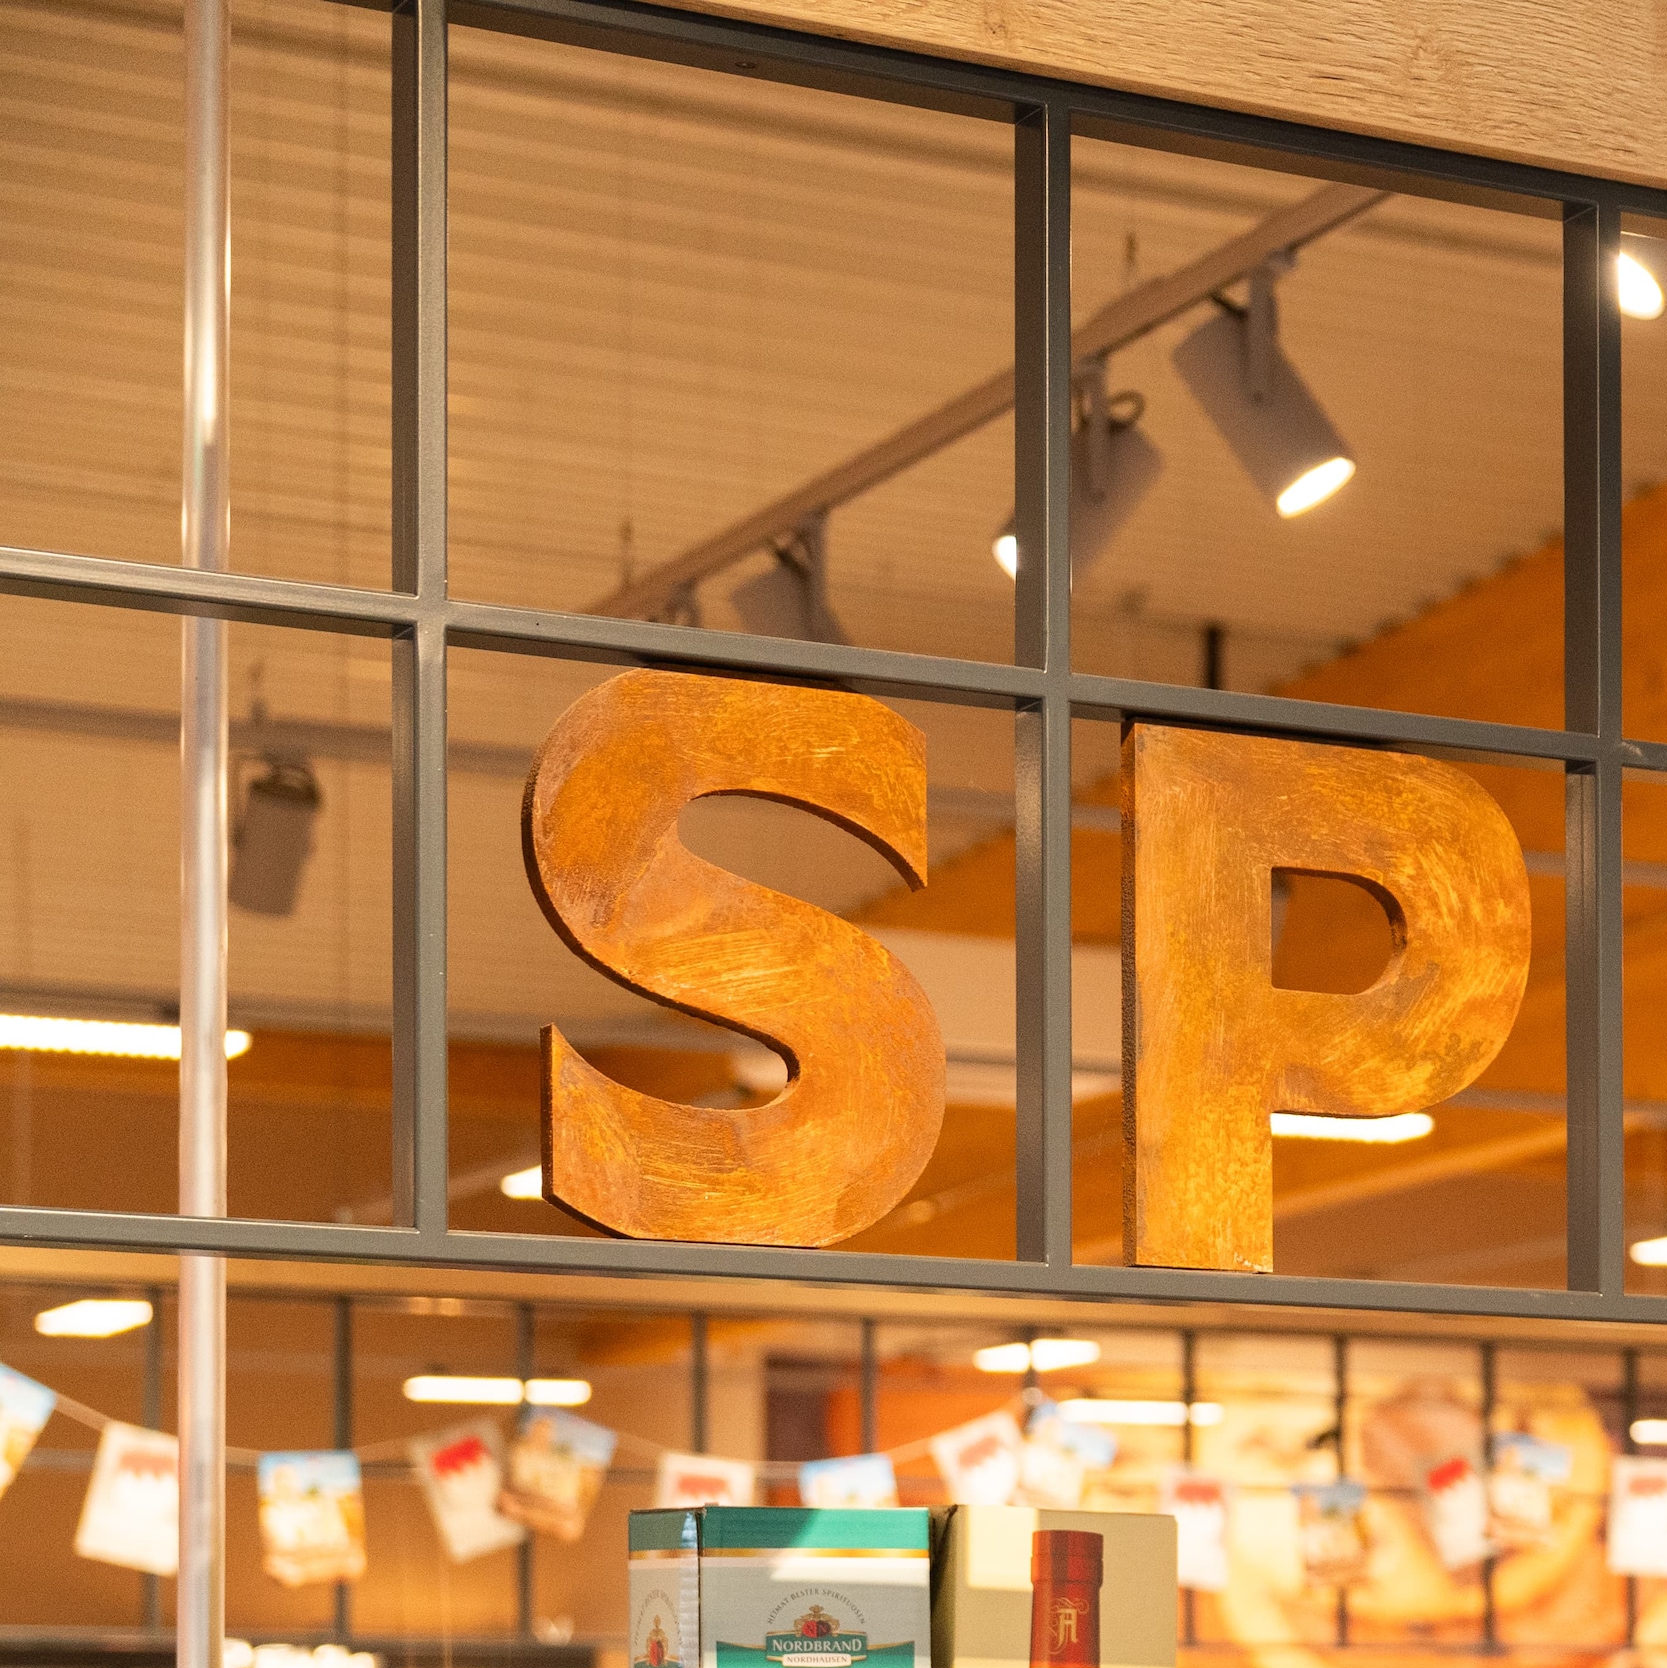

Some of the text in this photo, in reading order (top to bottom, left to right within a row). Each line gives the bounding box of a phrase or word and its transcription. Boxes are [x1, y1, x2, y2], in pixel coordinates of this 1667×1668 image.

[790, 1588, 820, 1600] BESTER
[772, 1639, 862, 1653] NORDBRAND
[786, 1655, 848, 1664] NORDHAUSEN
